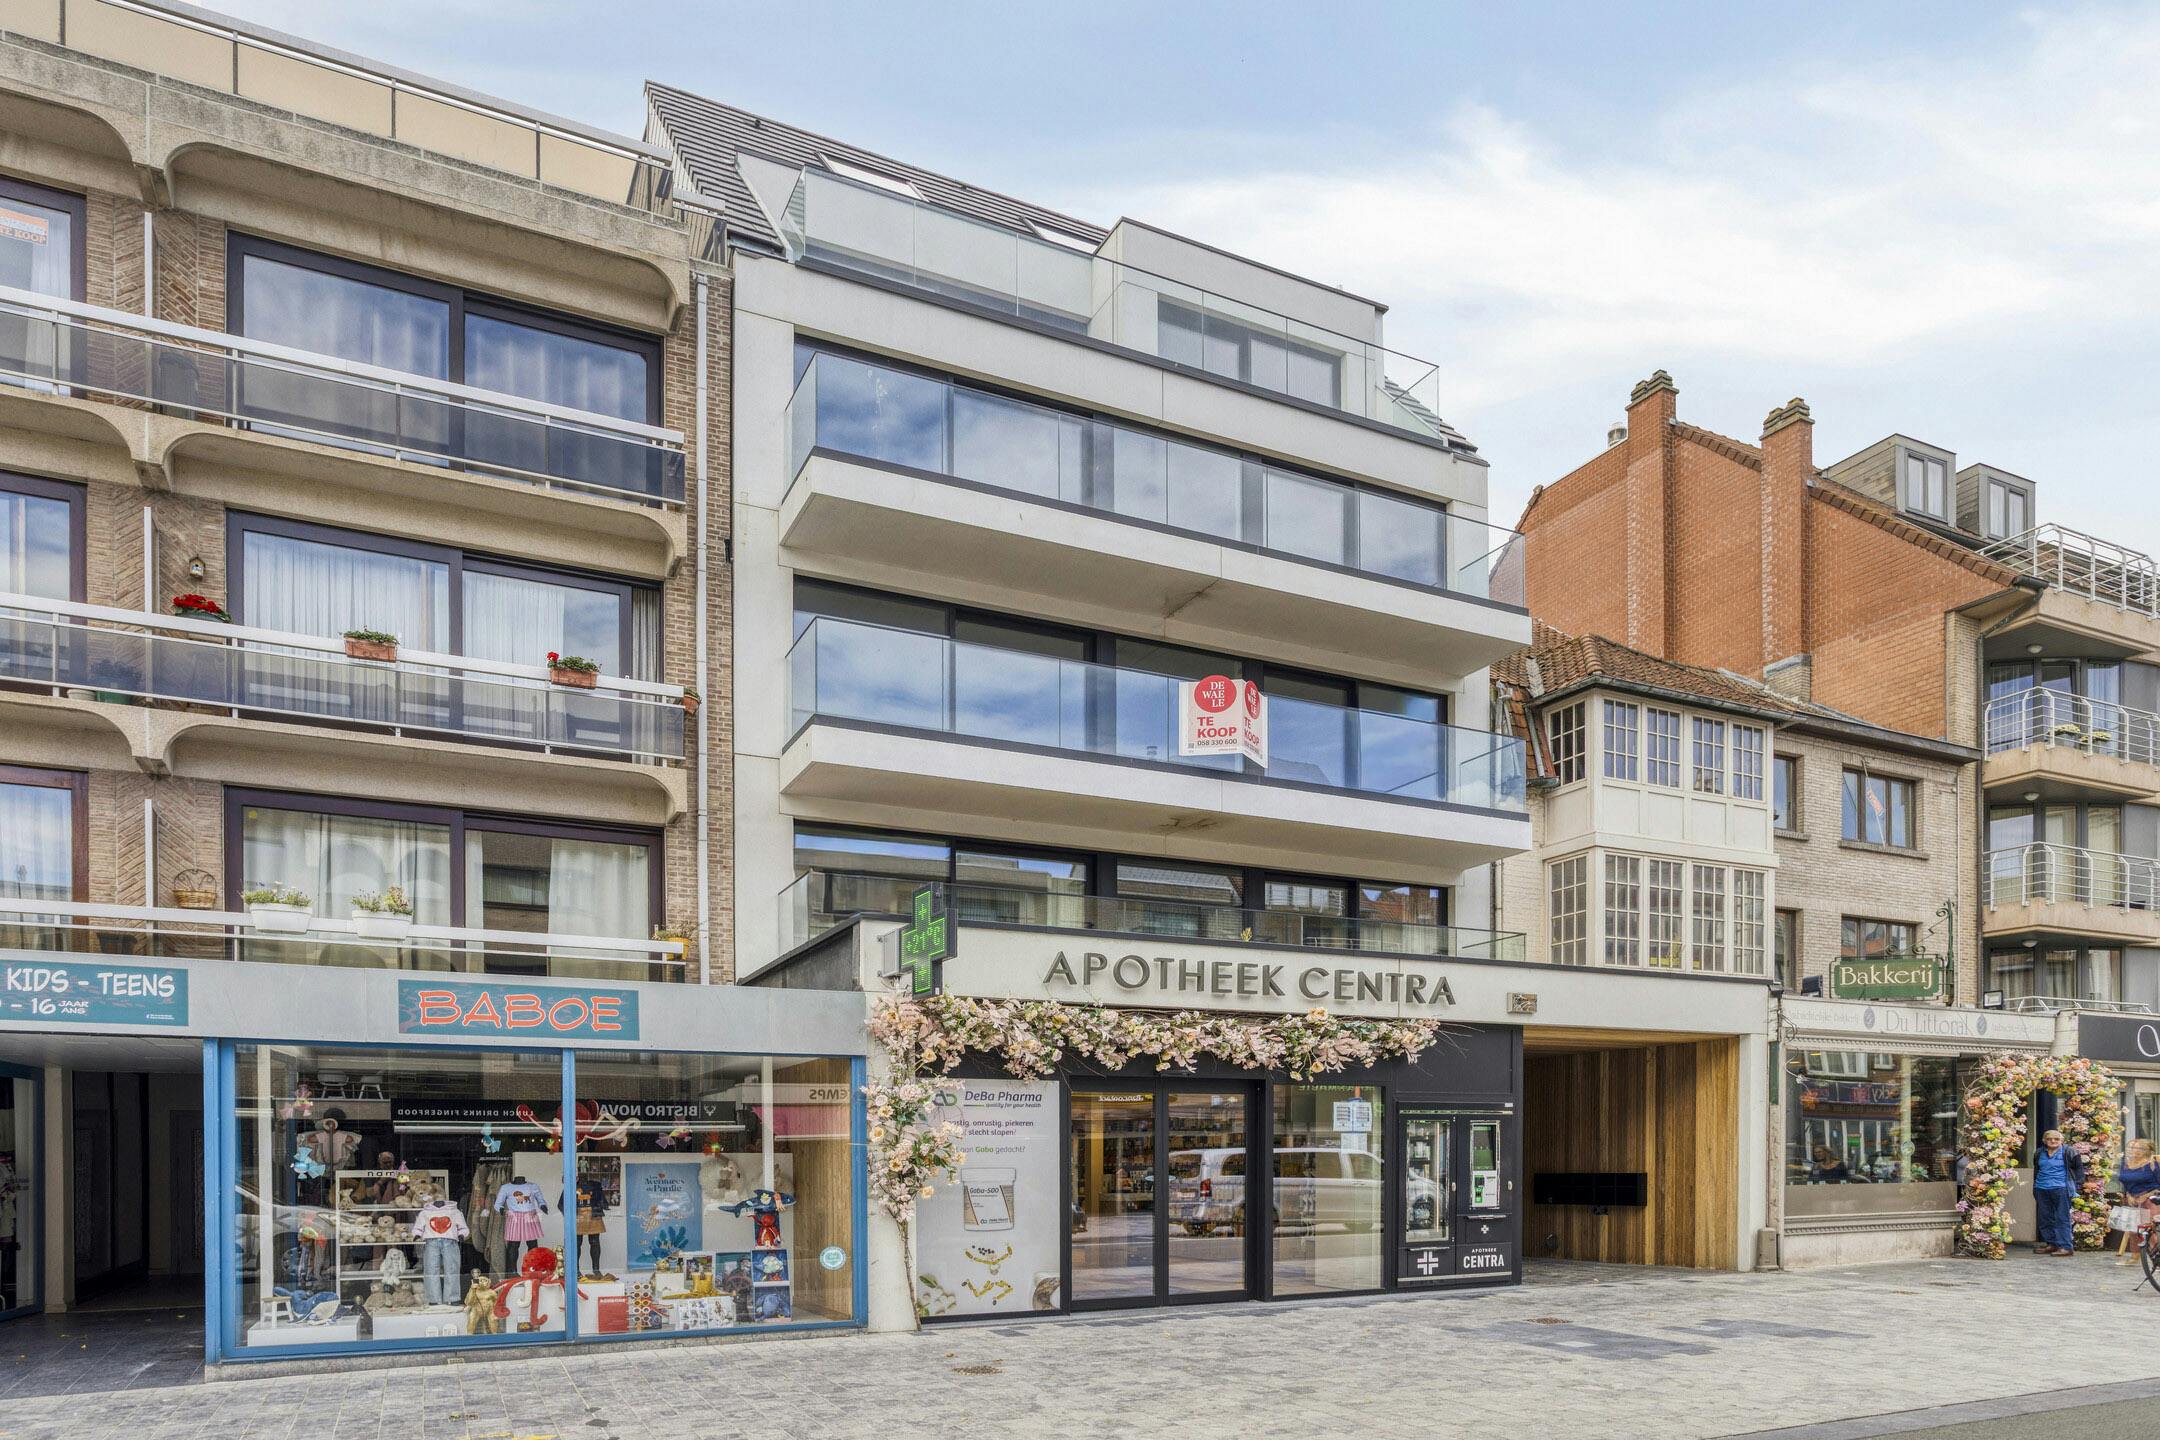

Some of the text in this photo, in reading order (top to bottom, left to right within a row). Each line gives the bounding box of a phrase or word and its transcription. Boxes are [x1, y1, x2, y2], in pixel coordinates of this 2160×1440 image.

[1210, 681, 1225, 690] DE
[1202, 691, 1225, 699] WAE
[1212, 699, 1225, 707] LE
[1197, 716, 1214, 726] TE
[1197, 726, 1237, 738] KOOP
[7, 967, 69, 993] KIDS
[97, 972, 175, 998] TEENS
[1043, 951, 1456, 1006] APOTHEEK CENTRA
[1839, 964, 1933, 990] Bakkerij
[31, 998, 56, 1014] 16
[58, 1000, 89, 1008] JAAR
[418, 990, 622, 1031] BABOE
[1886, 1009, 1908, 1032] Du
[1914, 1012, 1969, 1035] Littoral
[965, 1091, 1042, 1101] DeBa Pharma
[968, 1128, 990, 1136] slecht
[996, 1146, 1025, 1154] gedacht?
[1463, 1254, 1505, 1269] CENTRA
